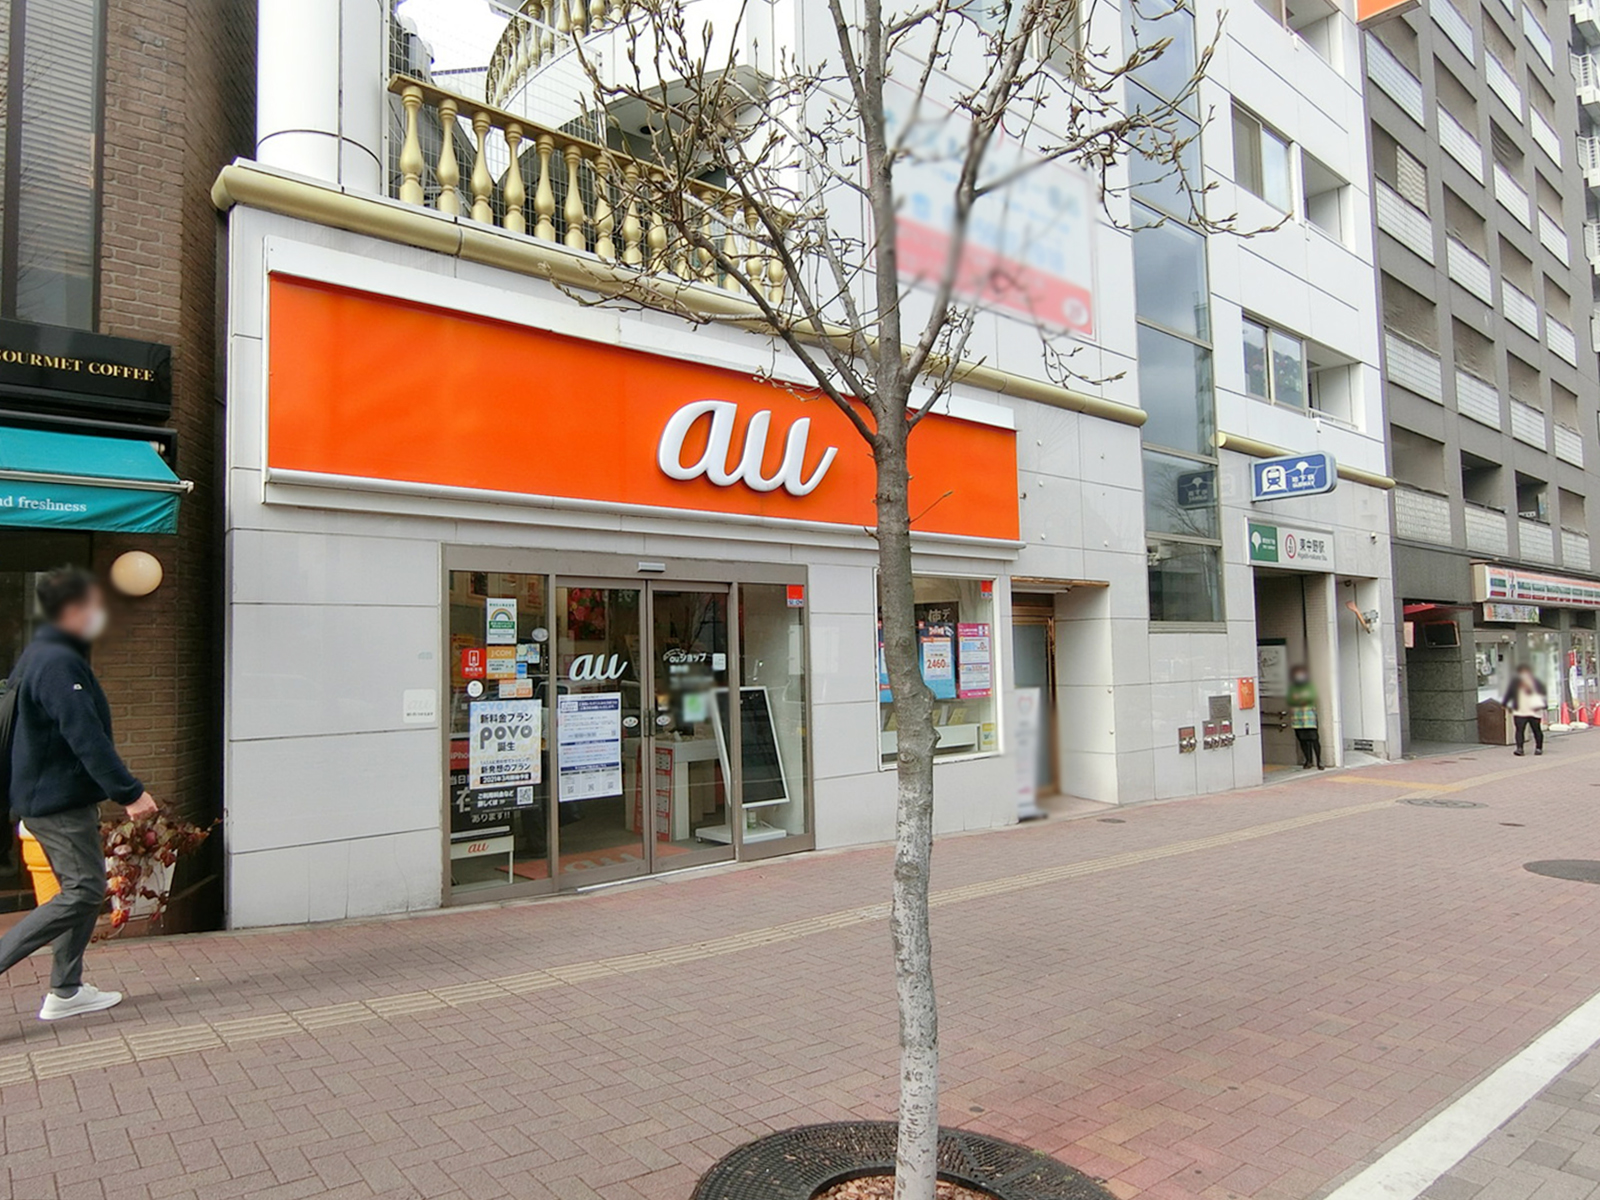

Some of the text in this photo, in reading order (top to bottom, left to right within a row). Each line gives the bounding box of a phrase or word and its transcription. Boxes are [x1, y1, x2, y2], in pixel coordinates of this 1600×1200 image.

[0, 350, 155, 382] OURMET COFFEE
[658, 399, 839, 497] au
[18, 496, 88, 512] freshness
[568, 653, 629, 682] au
[480, 712, 533, 724] 新料金プラン
[480, 725, 533, 750] povo
[481, 763, 531, 774] 新発想のプラン
[468, 842, 490, 854] au
